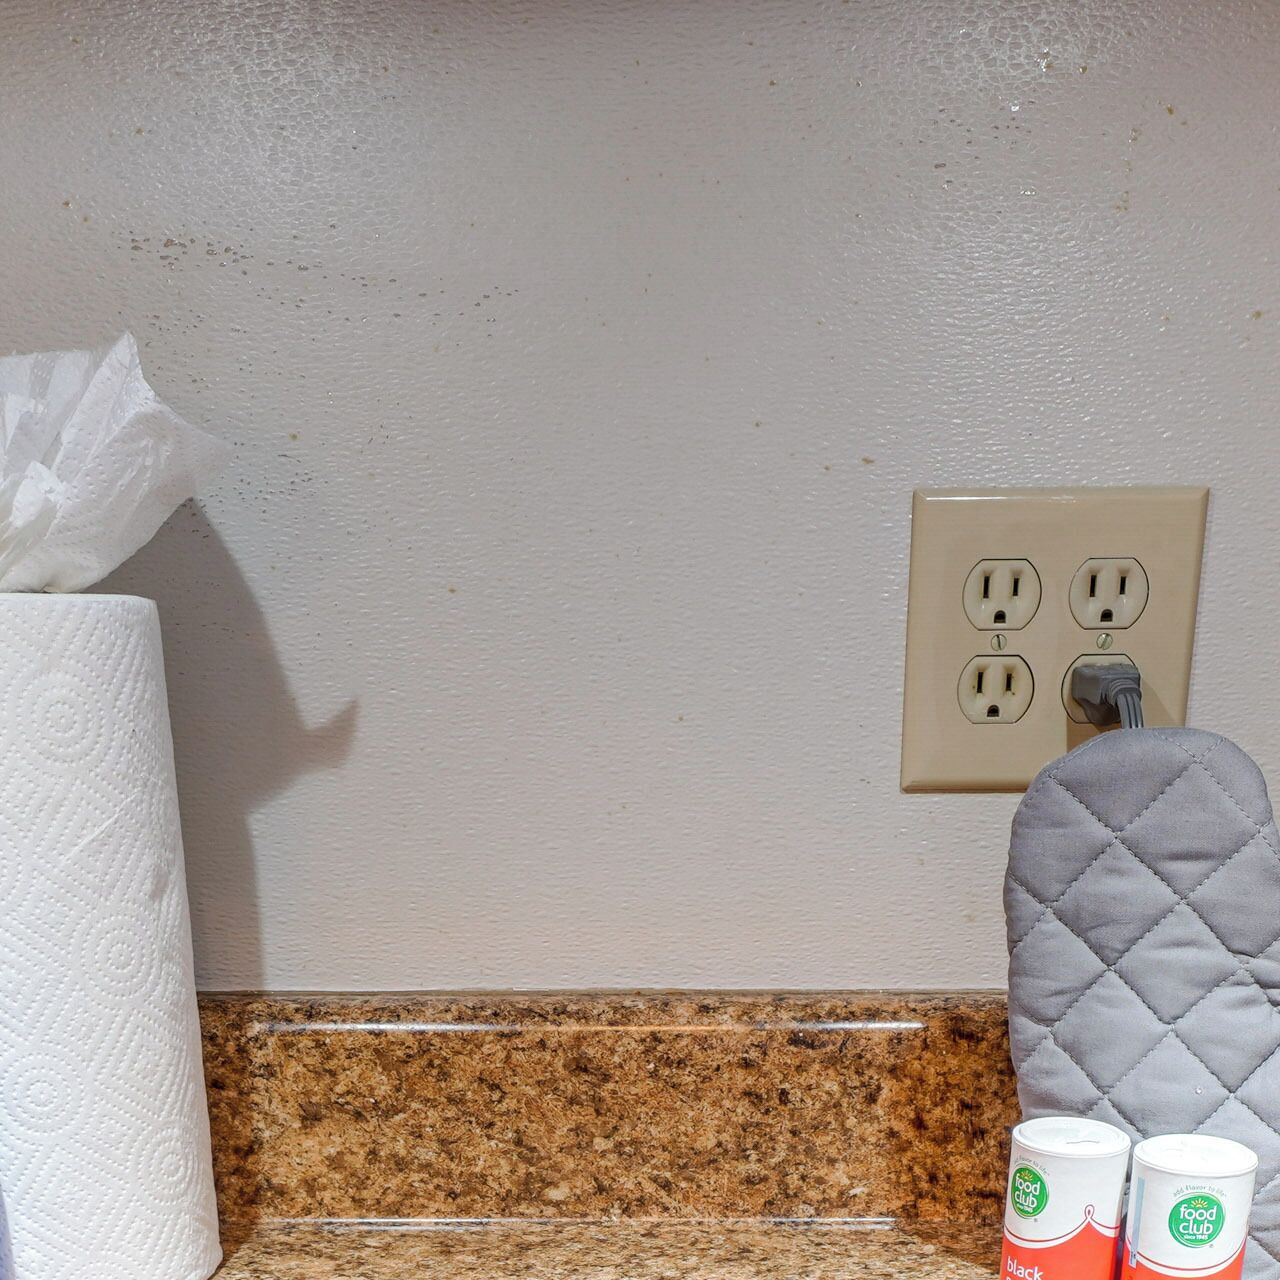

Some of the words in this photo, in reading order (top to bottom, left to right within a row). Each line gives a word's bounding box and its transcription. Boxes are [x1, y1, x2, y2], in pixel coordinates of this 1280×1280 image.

[1015, 1173, 1040, 1195] food
[1015, 1189, 1038, 1208] club
[1180, 1204, 1217, 1220] food
[1179, 1221, 1214, 1234] club
